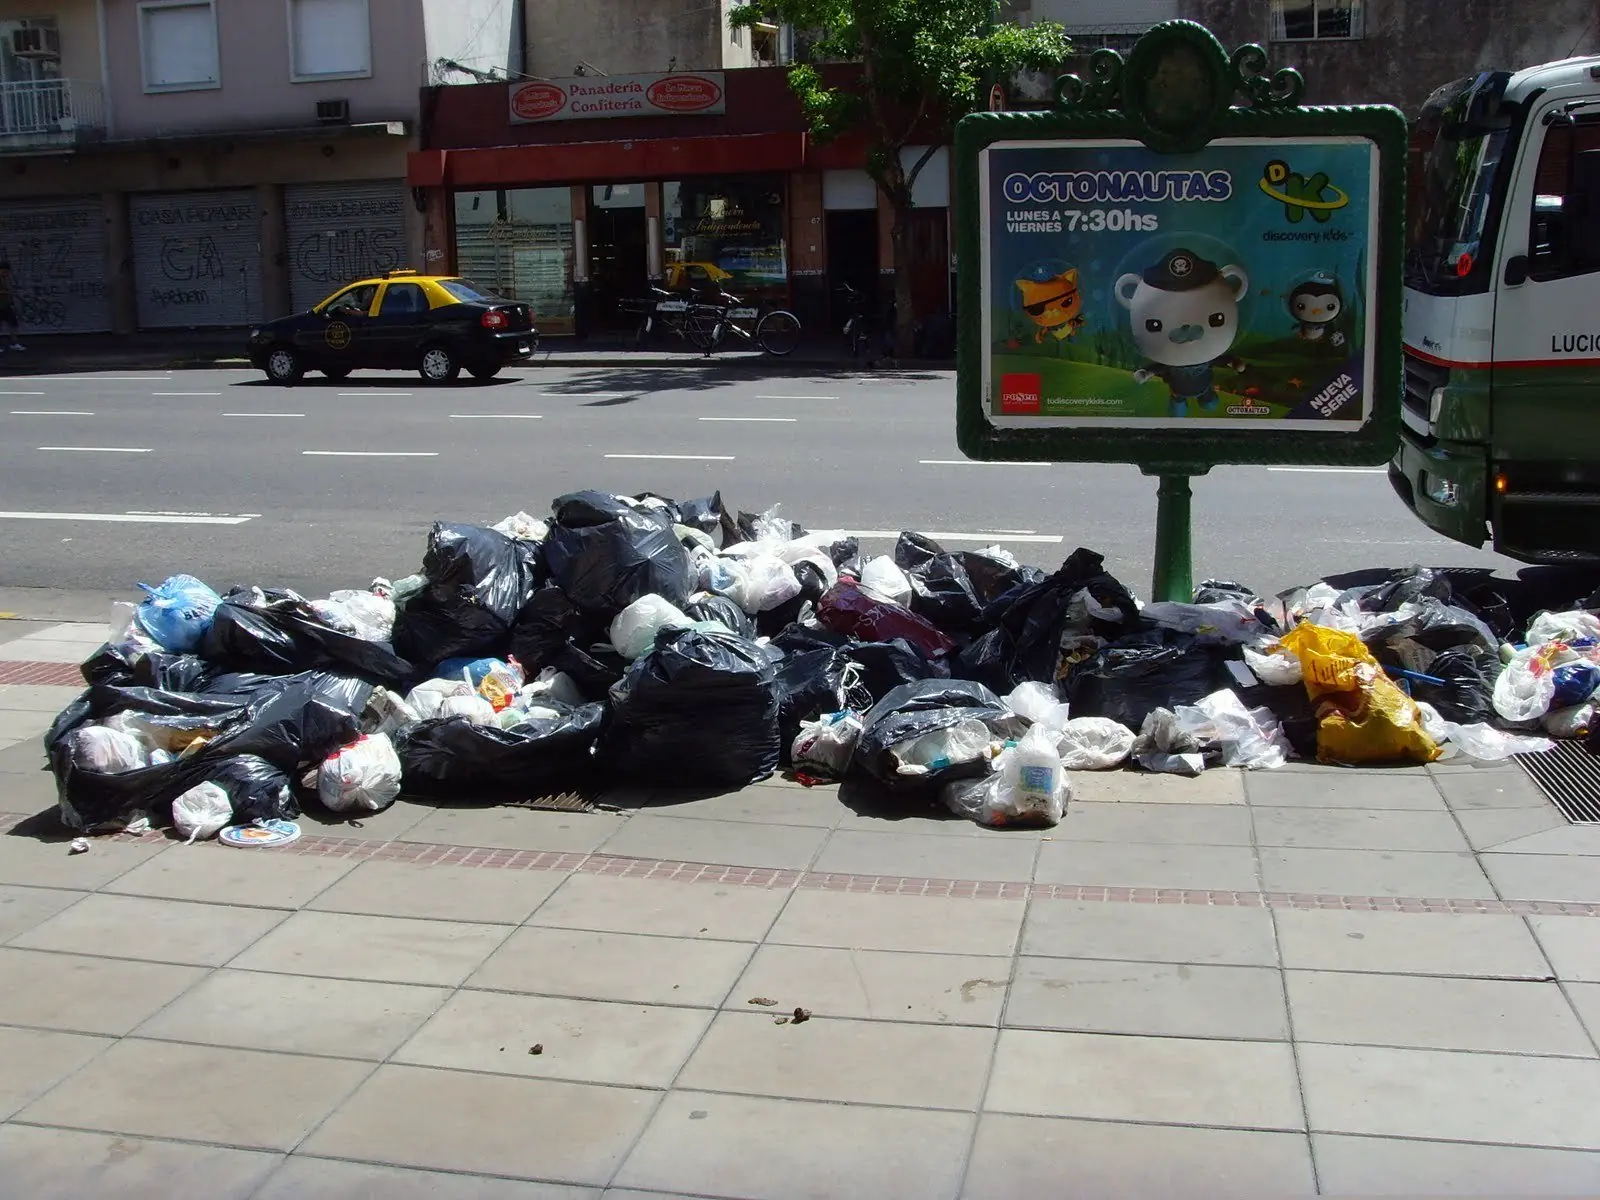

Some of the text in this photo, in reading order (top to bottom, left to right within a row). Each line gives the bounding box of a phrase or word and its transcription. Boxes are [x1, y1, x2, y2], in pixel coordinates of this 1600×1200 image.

[569, 81, 643, 96] Panadería
[571, 97, 643, 113] Confitería
[1003, 171, 1233, 203] OCTONAUTAS
[1006, 211, 1061, 221] LUNES A
[1064, 209, 1159, 232] 7:30hs
[1006, 223, 1063, 232] VIERNES
[1262, 230, 1320, 243] discovery
[1310, 373, 1352, 410] NUEVA
[1320, 384, 1358, 417] SERIE
